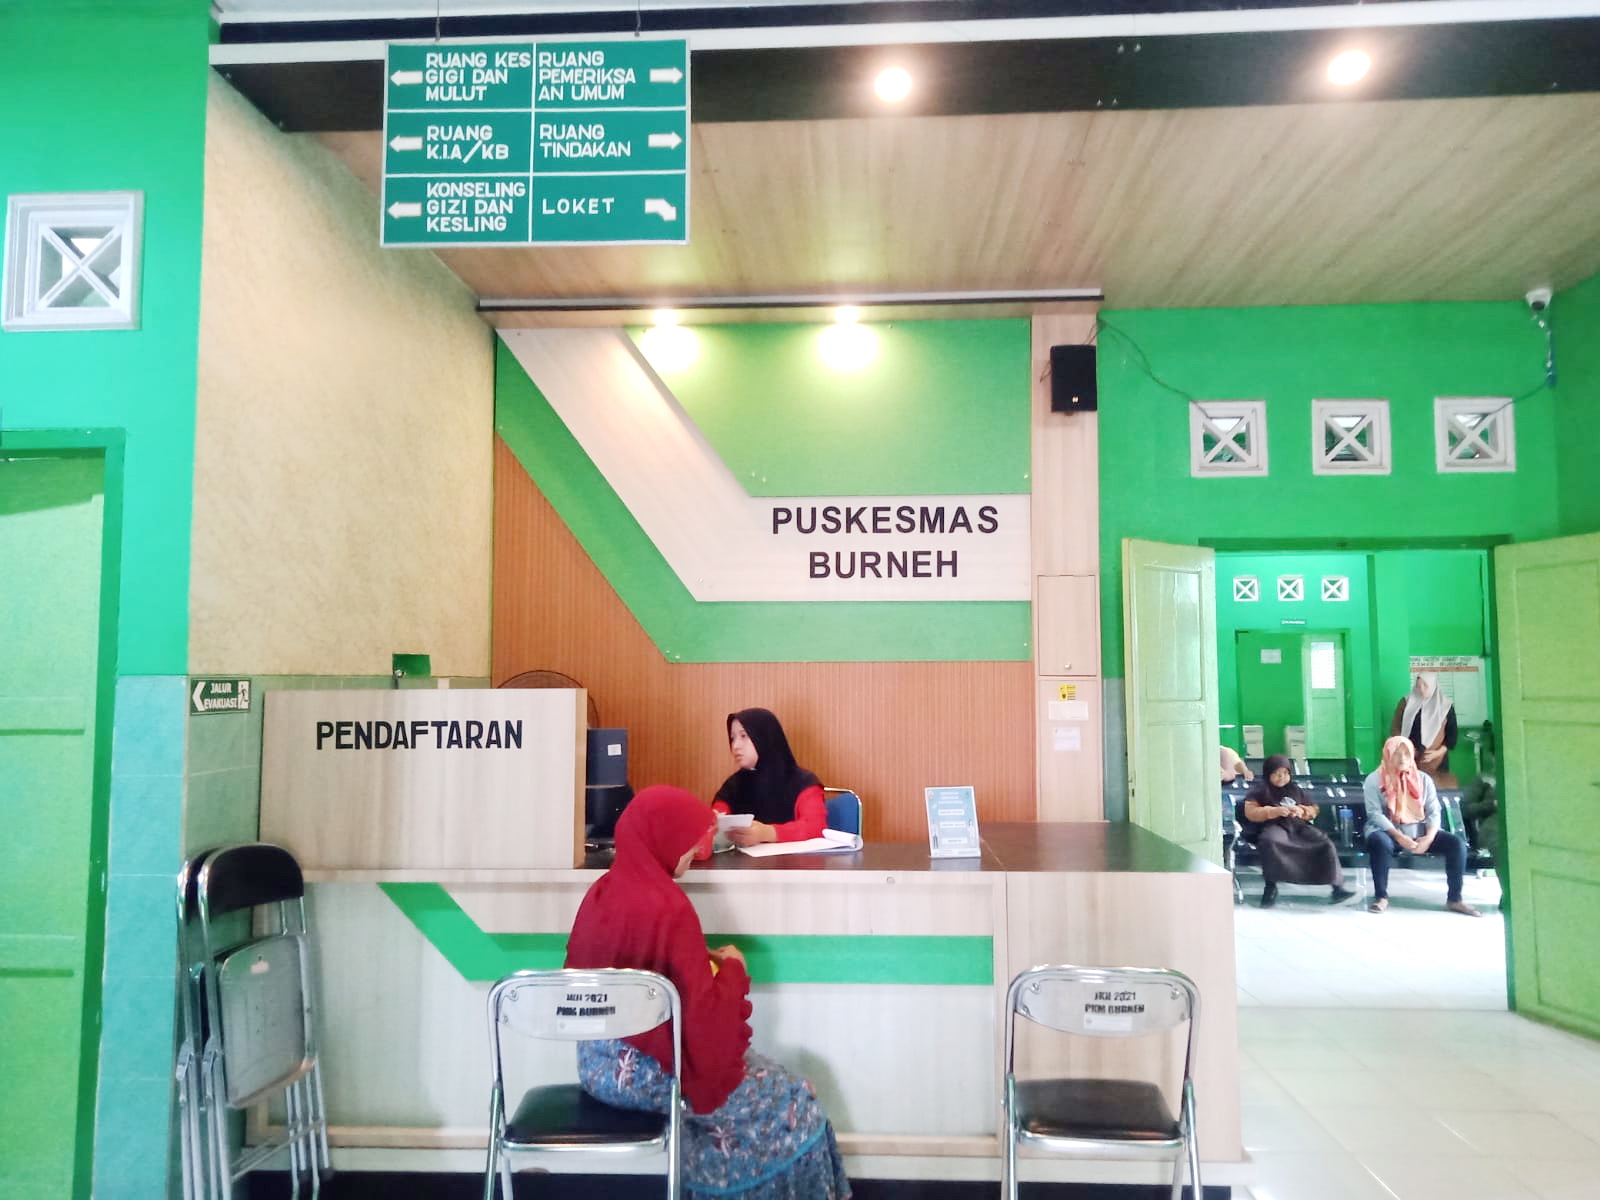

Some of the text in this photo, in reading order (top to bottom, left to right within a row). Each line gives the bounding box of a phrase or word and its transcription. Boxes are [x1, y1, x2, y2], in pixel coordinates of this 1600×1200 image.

[425, 51, 531, 68] RUANG KES
[539, 50, 605, 67] RUANG
[425, 68, 508, 85] GIGI DAN
[539, 67, 636, 85] PEMERIKSA
[425, 85, 488, 102] MULUT
[538, 83, 625, 101] AN UMUM
[426, 124, 493, 141] RUANG
[539, 123, 605, 140] RUANG
[539, 141, 631, 159] TINDAKAN
[426, 181, 526, 198] KONSELING
[426, 198, 513, 215] GIZI DAN
[542, 197, 615, 215] LOKET
[426, 216, 507, 233] KESLING
[772, 505, 999, 535] PUSKESMAS
[809, 550, 958, 579] BURNEH
[210, 682, 232, 694] JALUR
[203, 697, 238, 709] EVAKUASI
[316, 719, 523, 751] PENDAFTARAN
